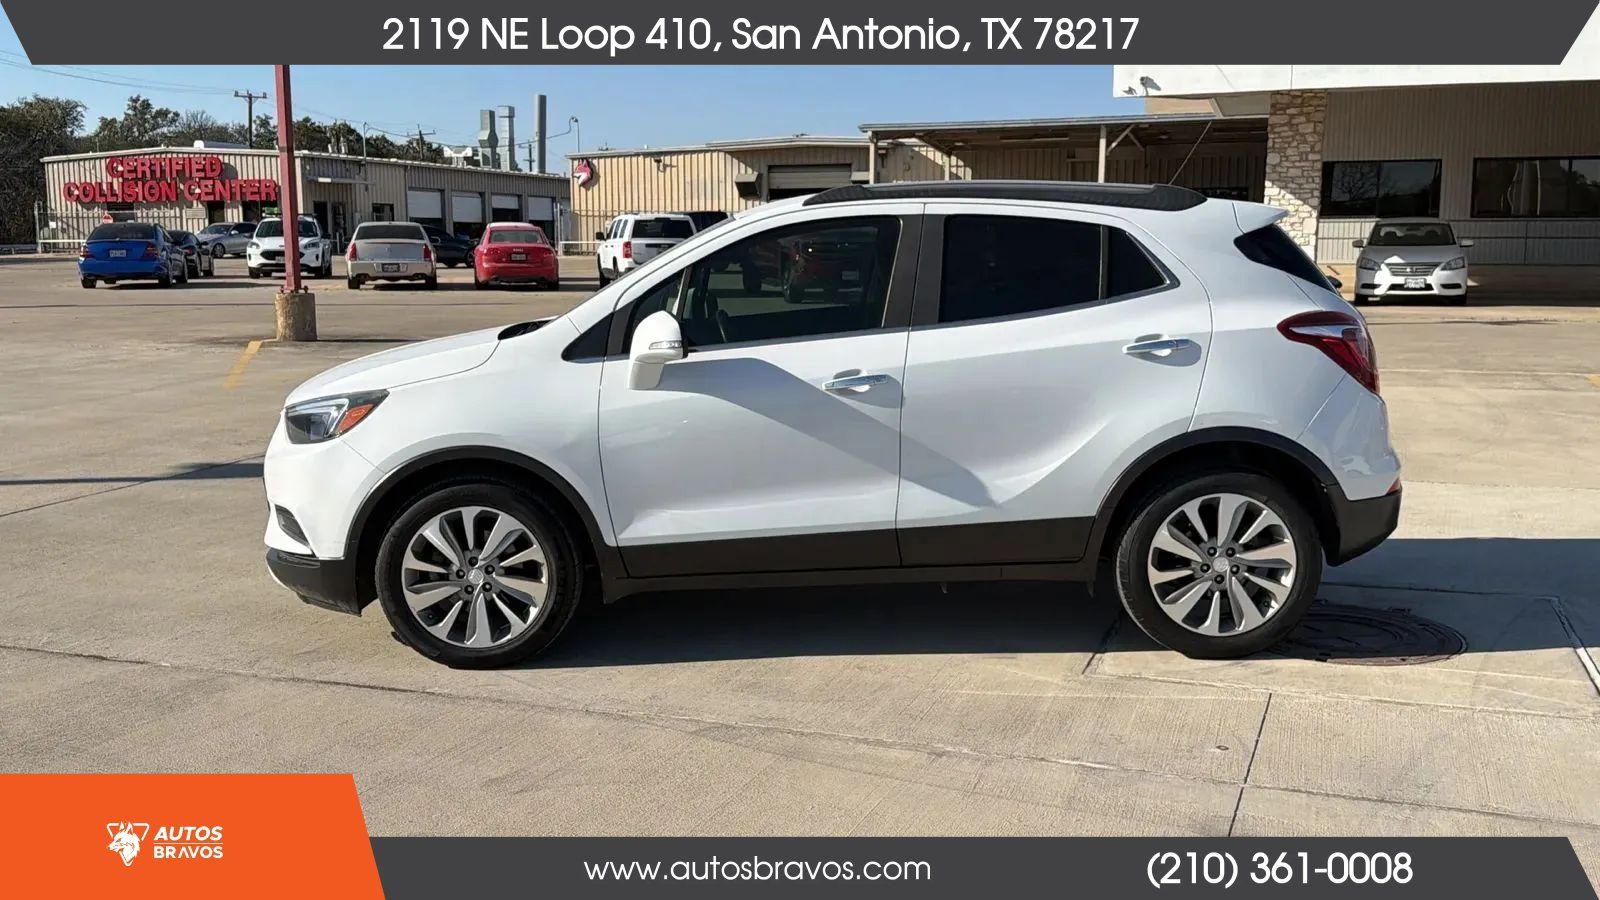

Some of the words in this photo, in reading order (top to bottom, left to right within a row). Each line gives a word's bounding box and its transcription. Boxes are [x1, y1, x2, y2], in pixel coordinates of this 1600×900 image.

[107, 156, 222, 179] CERTIFIED
[63, 179, 178, 203] COLLISION
[184, 179, 277, 202] CENTER
